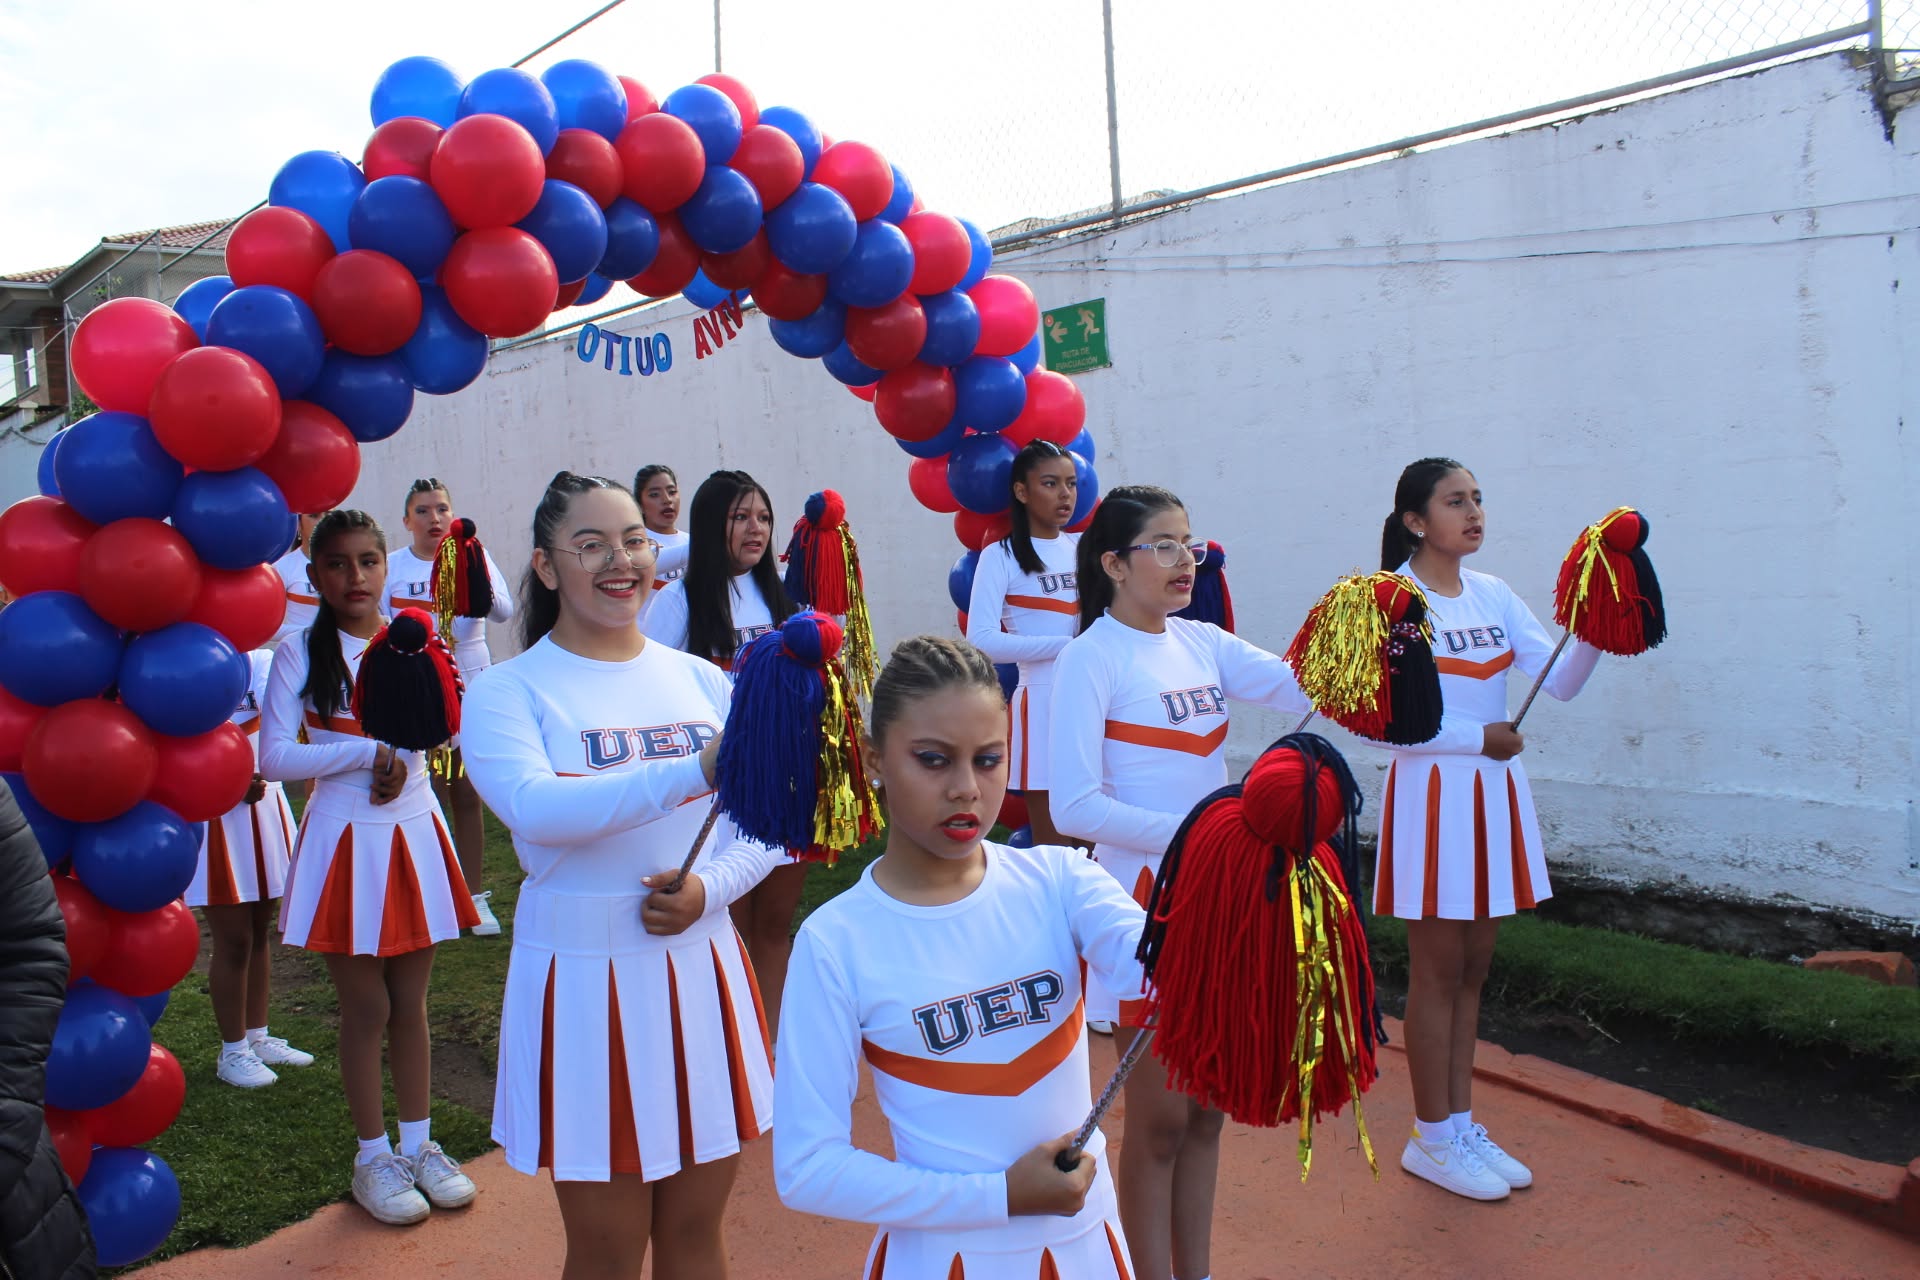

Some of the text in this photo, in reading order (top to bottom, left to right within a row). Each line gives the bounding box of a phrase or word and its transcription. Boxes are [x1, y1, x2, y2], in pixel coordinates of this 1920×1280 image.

[1080, 346, 1089, 355] DE
[1037, 572, 1077, 595] UE
[1440, 625, 1505, 655] UEP
[1160, 684, 1225, 725] UEP
[912, 970, 1064, 1056] UEP
